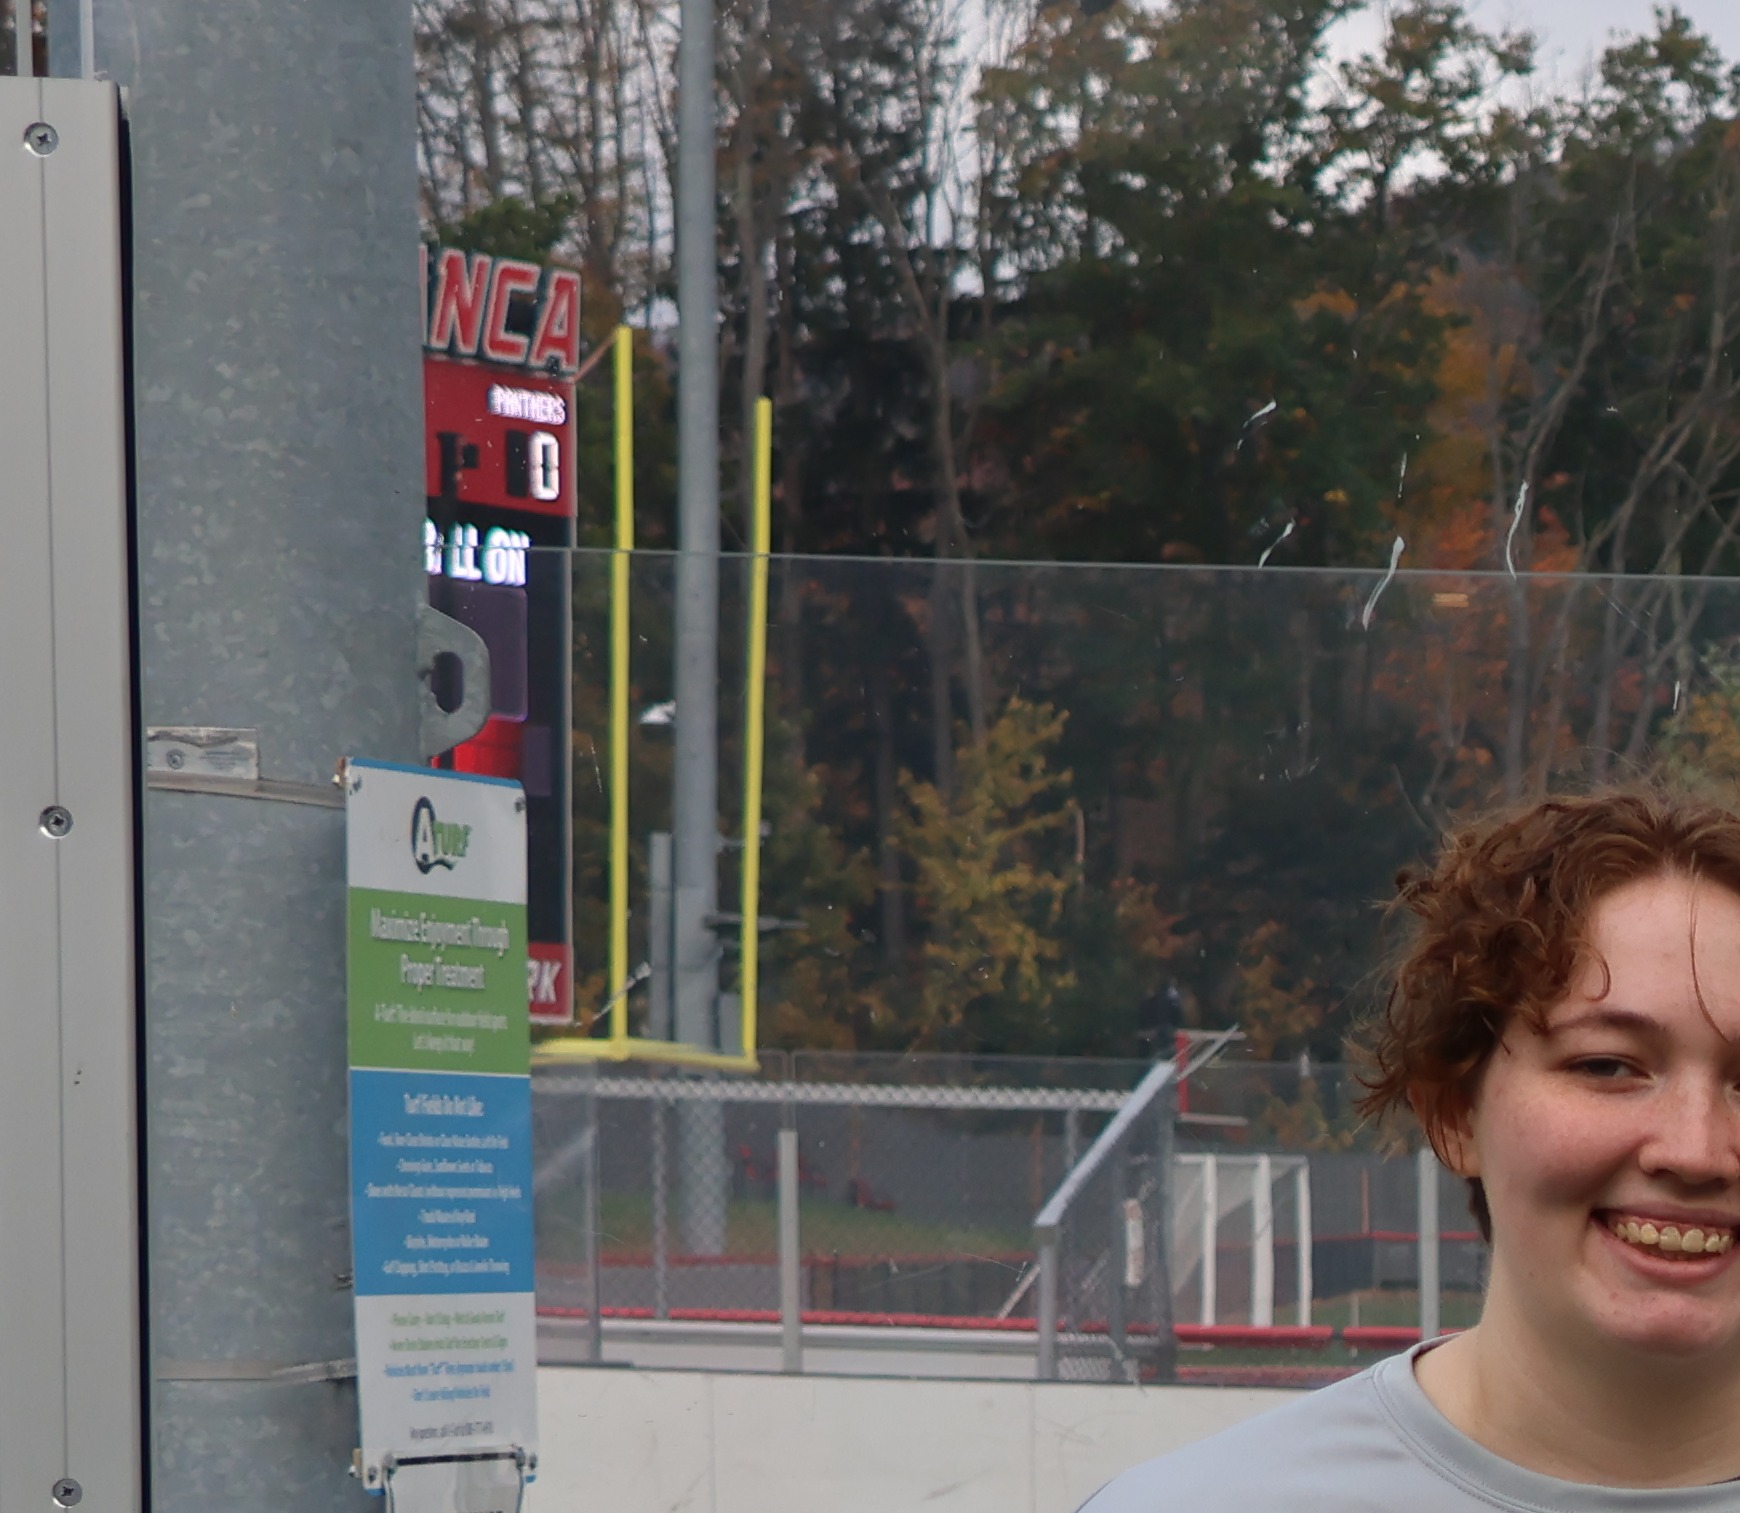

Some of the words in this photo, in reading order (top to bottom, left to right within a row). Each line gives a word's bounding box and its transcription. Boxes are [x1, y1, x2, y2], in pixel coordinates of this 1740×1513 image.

[420, 245, 581, 372] NCA
[527, 430, 561, 502] 0
[482, 526, 530, 587] ON
[401, 953, 434, 992] Proper
[434, 956, 486, 989] Treatment
